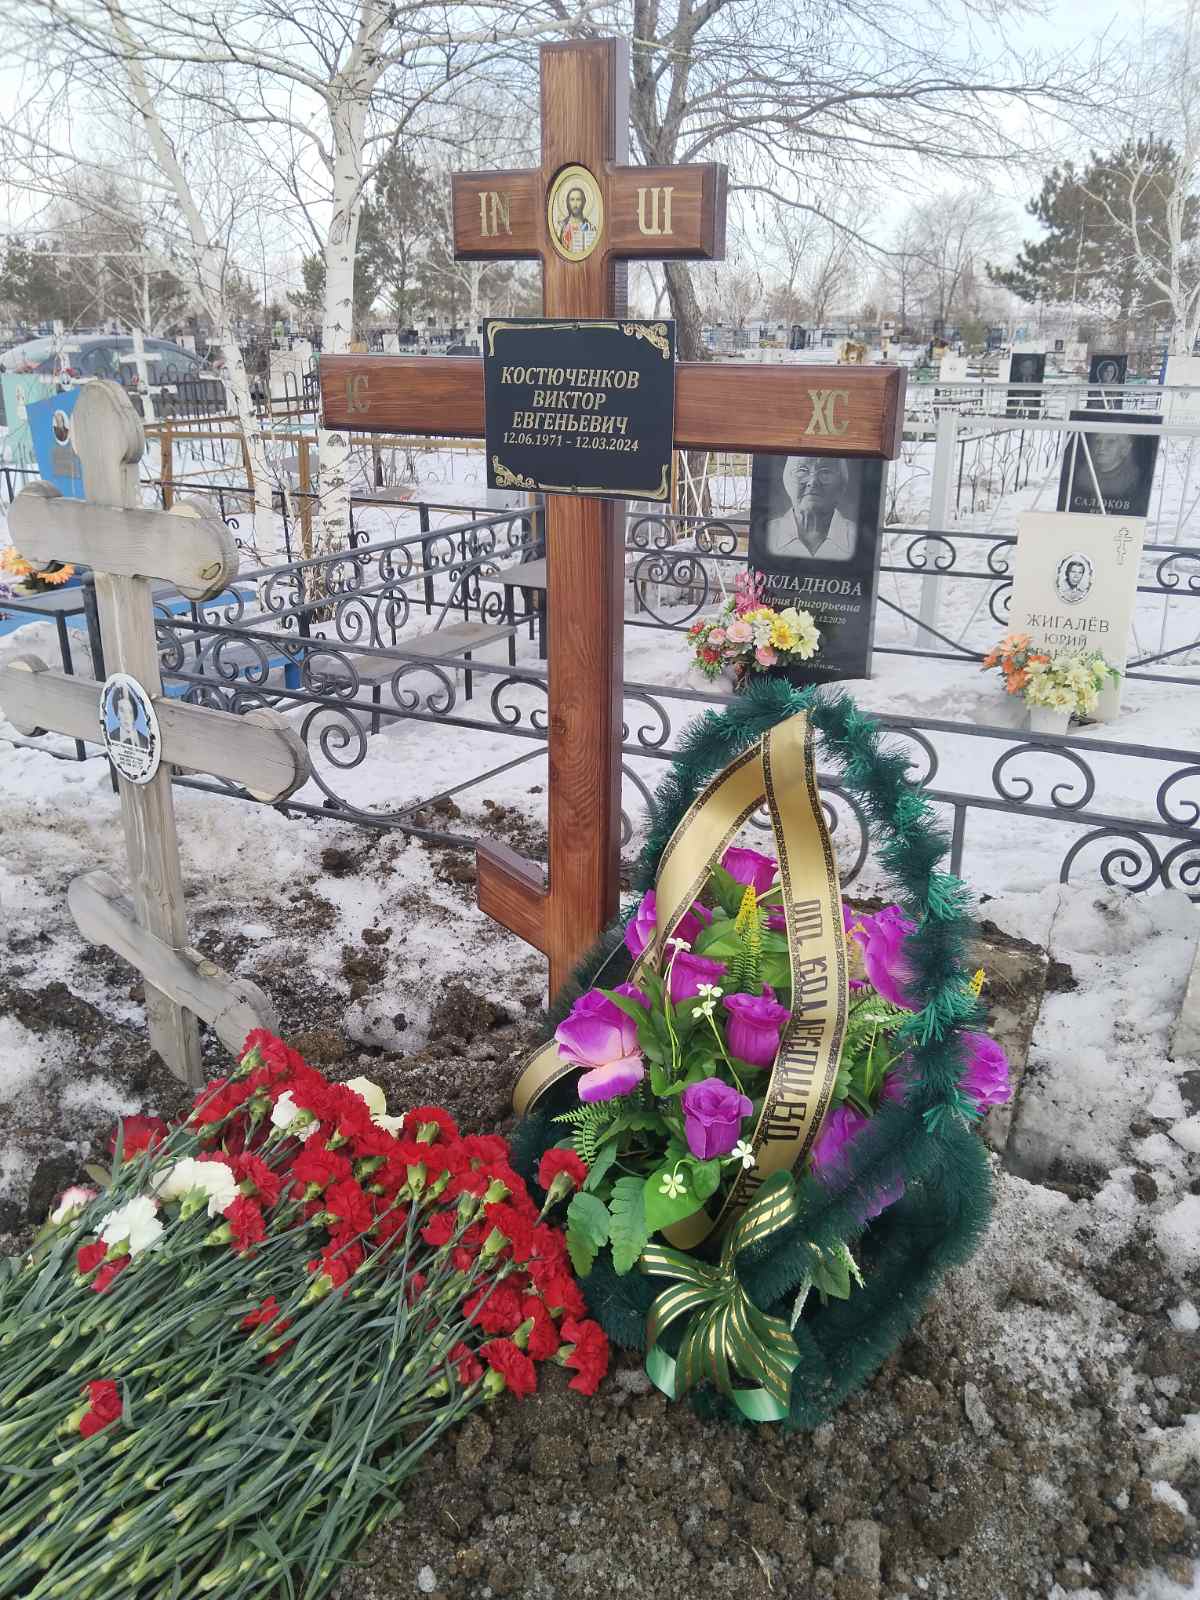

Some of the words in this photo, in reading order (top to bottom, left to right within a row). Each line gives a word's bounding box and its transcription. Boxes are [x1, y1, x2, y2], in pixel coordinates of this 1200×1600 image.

[501, 366, 640, 389] КОСТЮЧЕНКОВ
[532, 390, 607, 410] ВИКТОР
[511, 411, 629, 435] ЕВГЕНЬЕВИЧ
[503, 432, 562, 447] 12.06.1971
[575, 436, 639, 452] 12.03.2024
[1026, 613, 1110, 633] ЖИГАЛЁВ
[1044, 633, 1087, 647] ЮРИЙ
